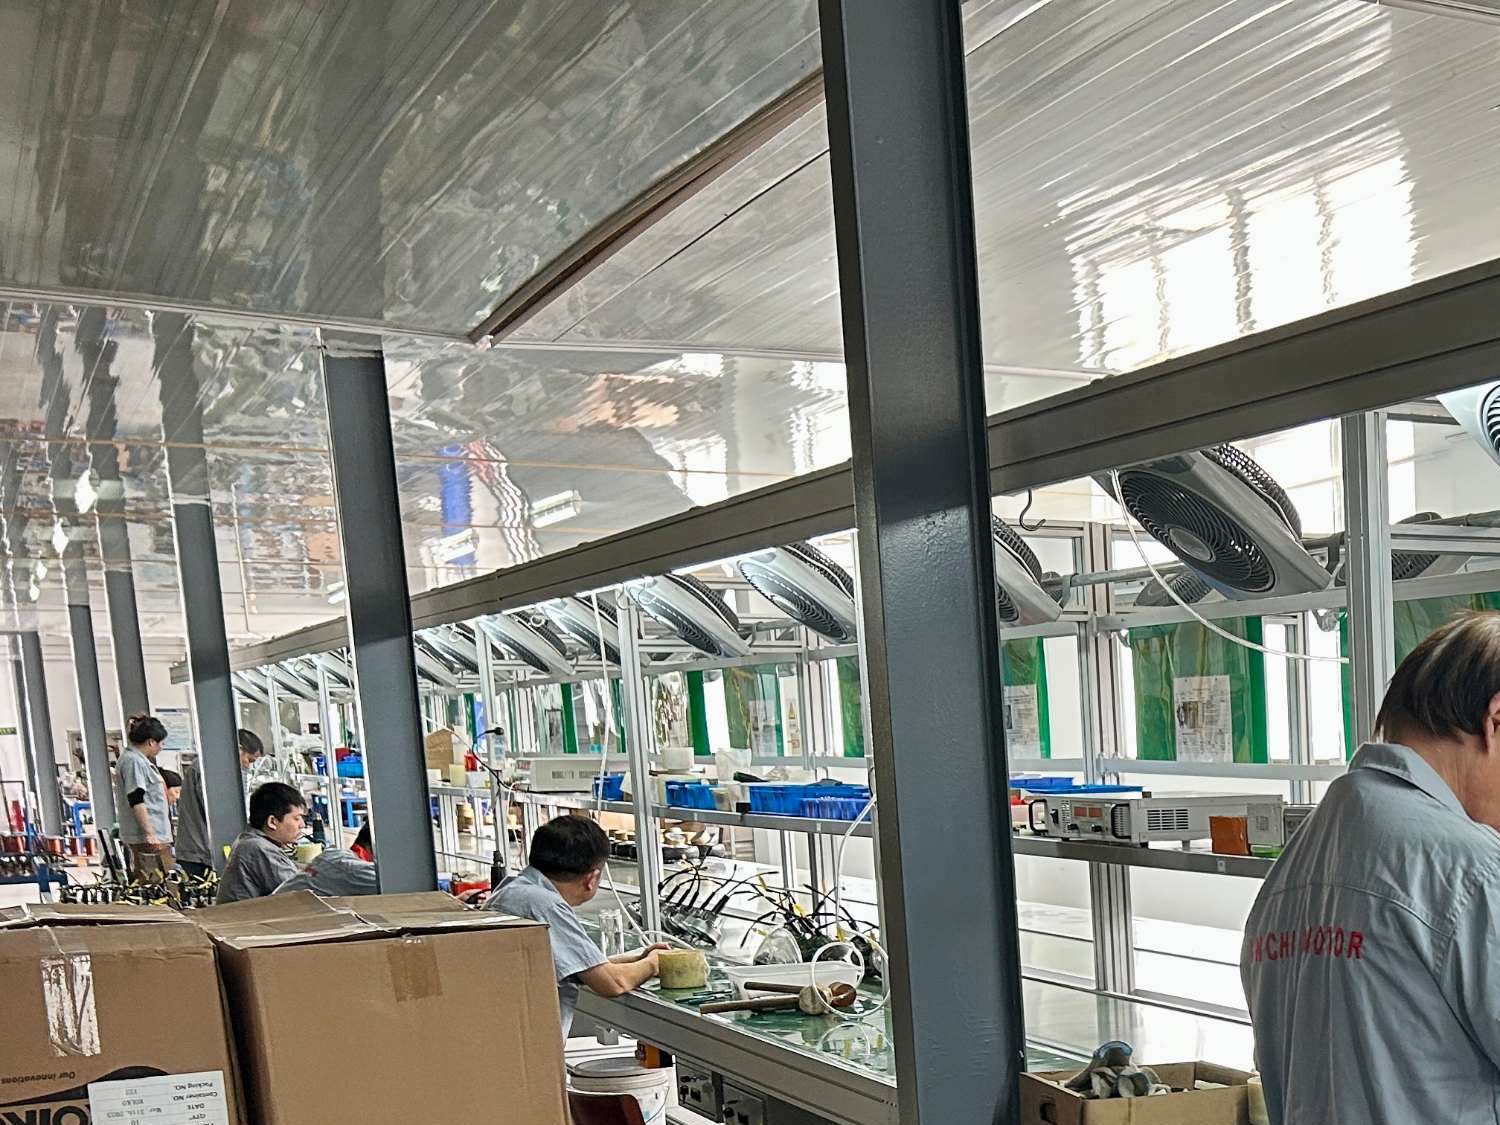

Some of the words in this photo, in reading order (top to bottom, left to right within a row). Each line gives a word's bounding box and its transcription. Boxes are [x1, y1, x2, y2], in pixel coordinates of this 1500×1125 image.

[1, 1073, 57, 1085] innovations
[59, 1071, 76, 1079] Our
[186, 1091, 218, 1099] Container
